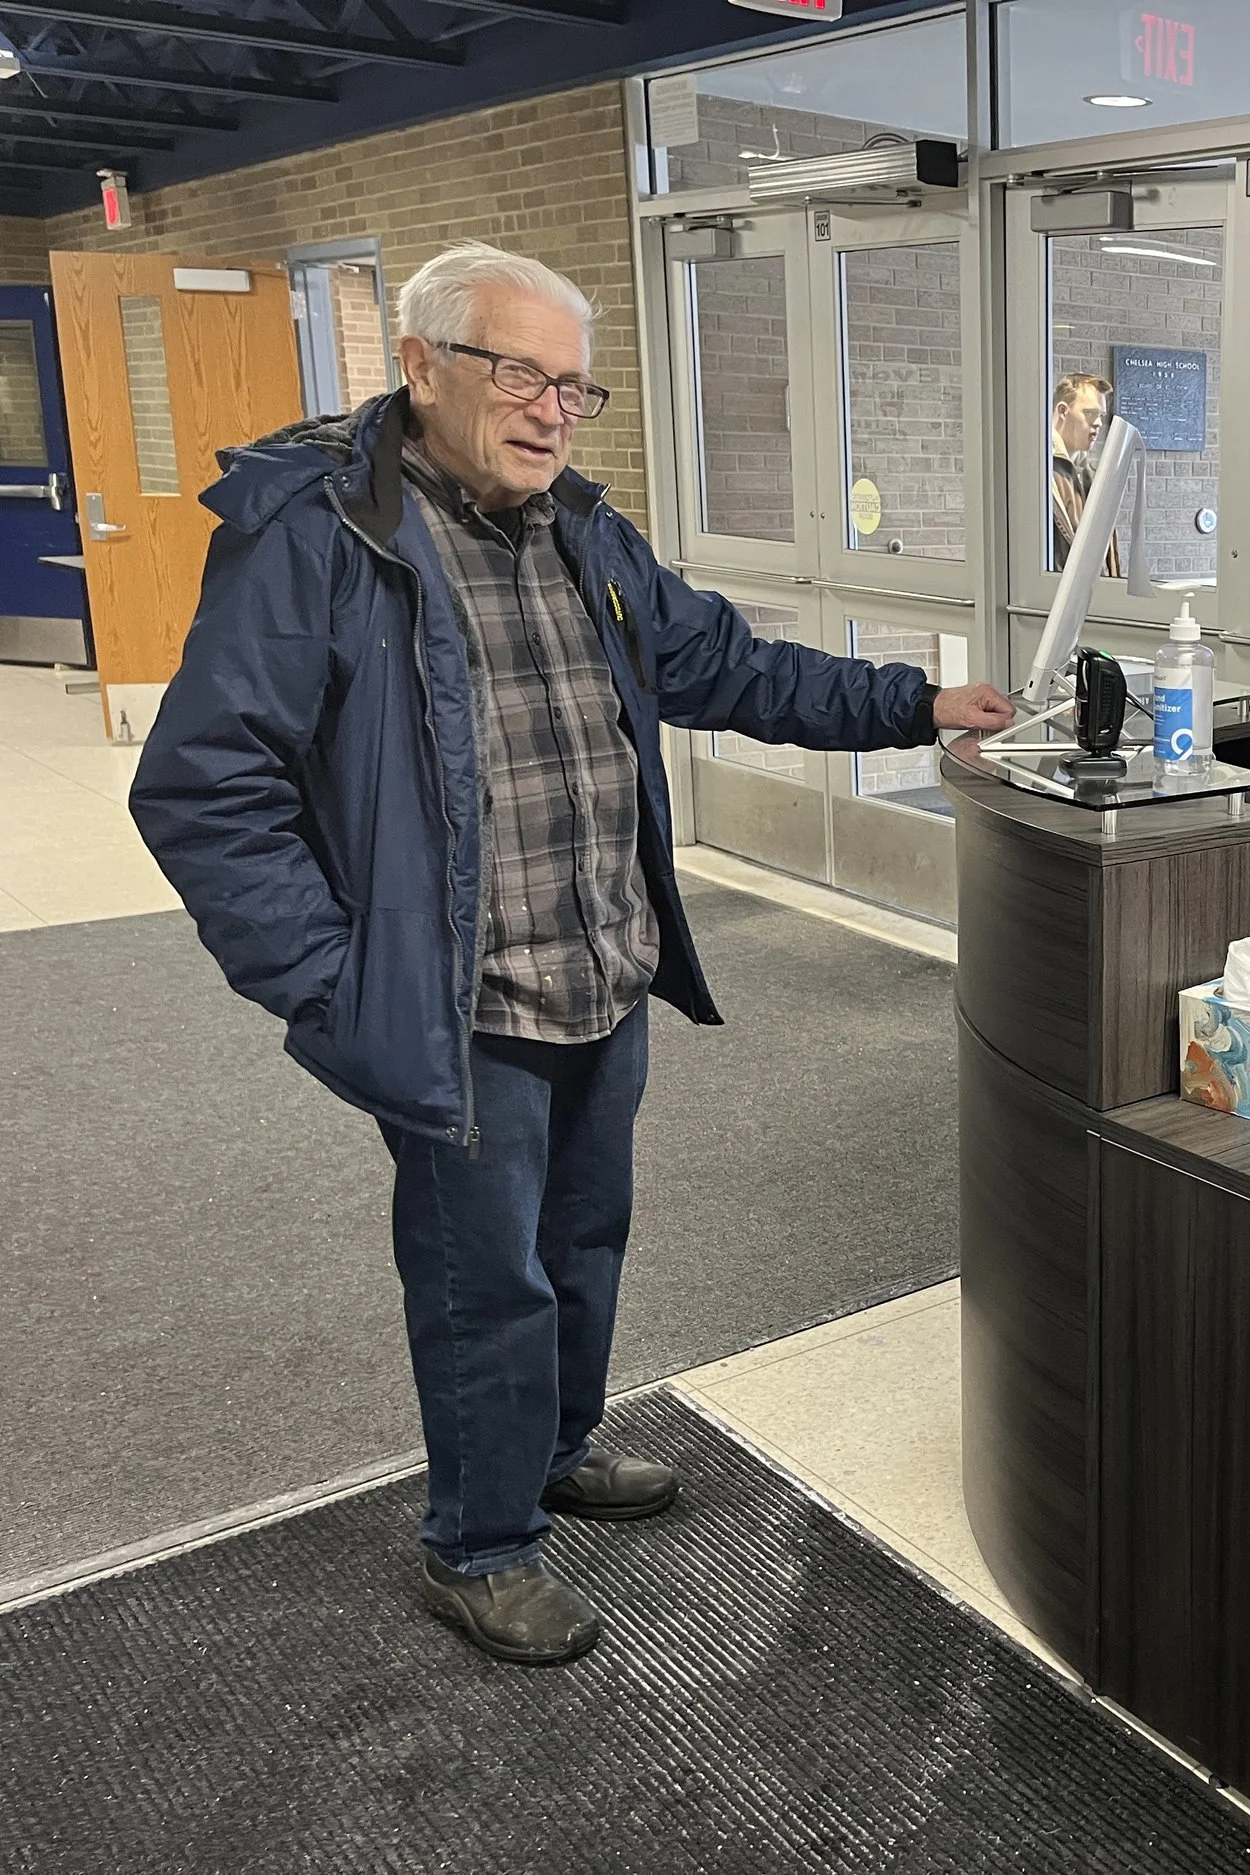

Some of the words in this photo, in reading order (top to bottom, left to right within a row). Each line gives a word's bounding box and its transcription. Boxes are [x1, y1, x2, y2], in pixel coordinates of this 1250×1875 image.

[816, 223, 829, 237] 101
[1125, 358, 1153, 367] CHELSEA
[1156, 361, 1172, 369] HIGH
[1175, 362, 1200, 370] SCHOOL
